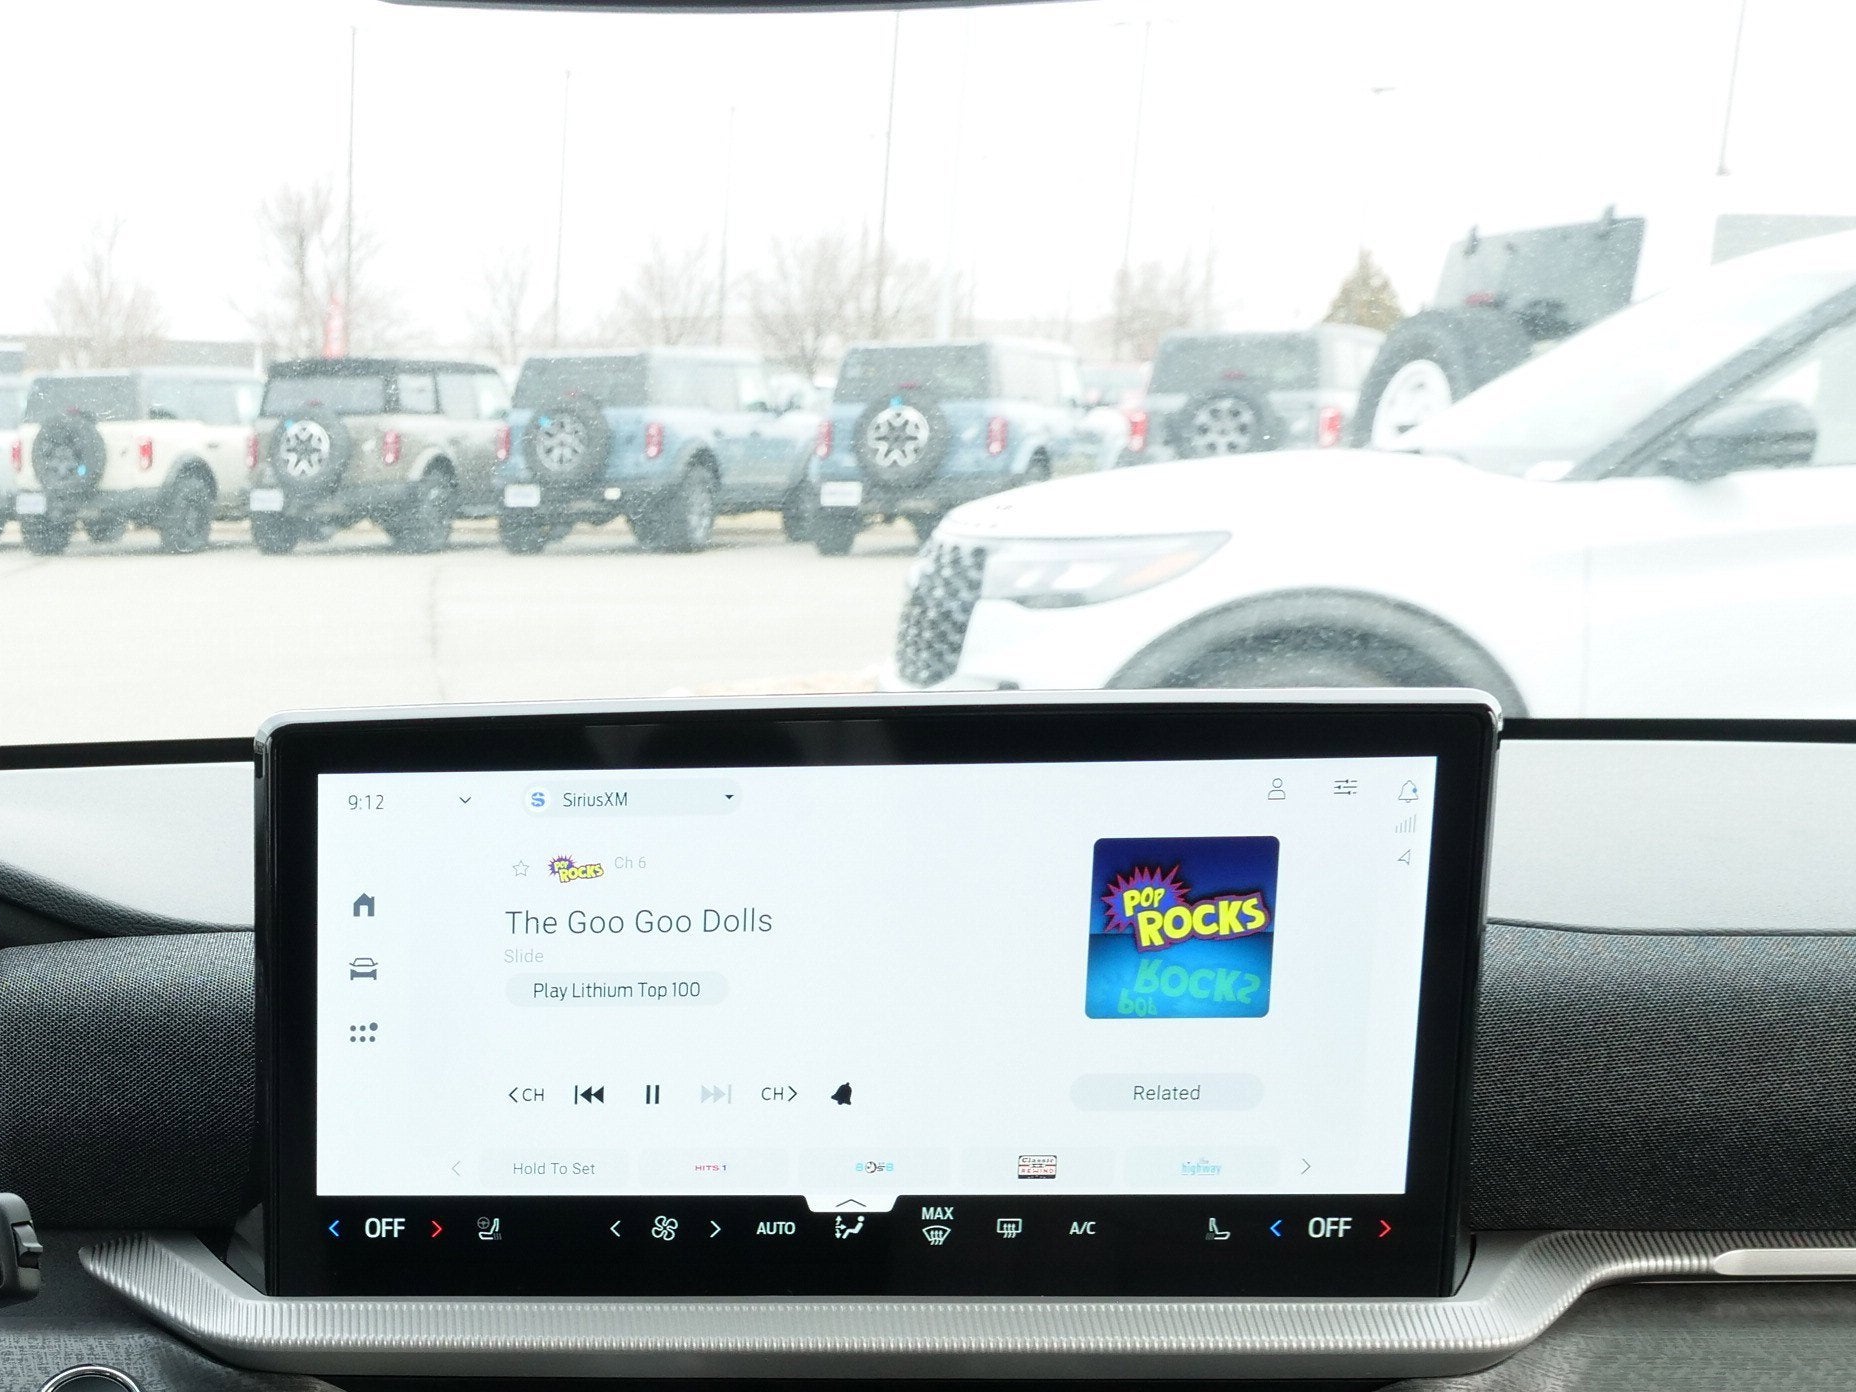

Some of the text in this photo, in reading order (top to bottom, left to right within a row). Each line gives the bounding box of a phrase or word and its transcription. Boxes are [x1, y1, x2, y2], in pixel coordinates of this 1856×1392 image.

[347, 793, 385, 811] 9:12
[562, 792, 628, 808] SiriusXM
[614, 856, 646, 869] Ch 6
[559, 864, 604, 882] ROCKS
[1122, 886, 1166, 917] POP
[505, 907, 773, 935] The Goo Goo Dolls
[1136, 897, 1266, 948] ROCKS
[503, 949, 544, 964] Slide
[533, 981, 701, 1002] Play Lithium Top 100
[522, 1088, 545, 1102] CH
[761, 1087, 784, 1101] CH
[1133, 1085, 1201, 1101] Related
[512, 1161, 596, 1175] Hold To Set
[694, 1164, 727, 1172] HITS 1
[921, 1207, 954, 1220] MAX
[364, 1217, 406, 1238] OFF
[756, 1221, 796, 1235] AUTO
[1069, 1220, 1096, 1236] A/C
[1308, 1217, 1352, 1238] OFF
